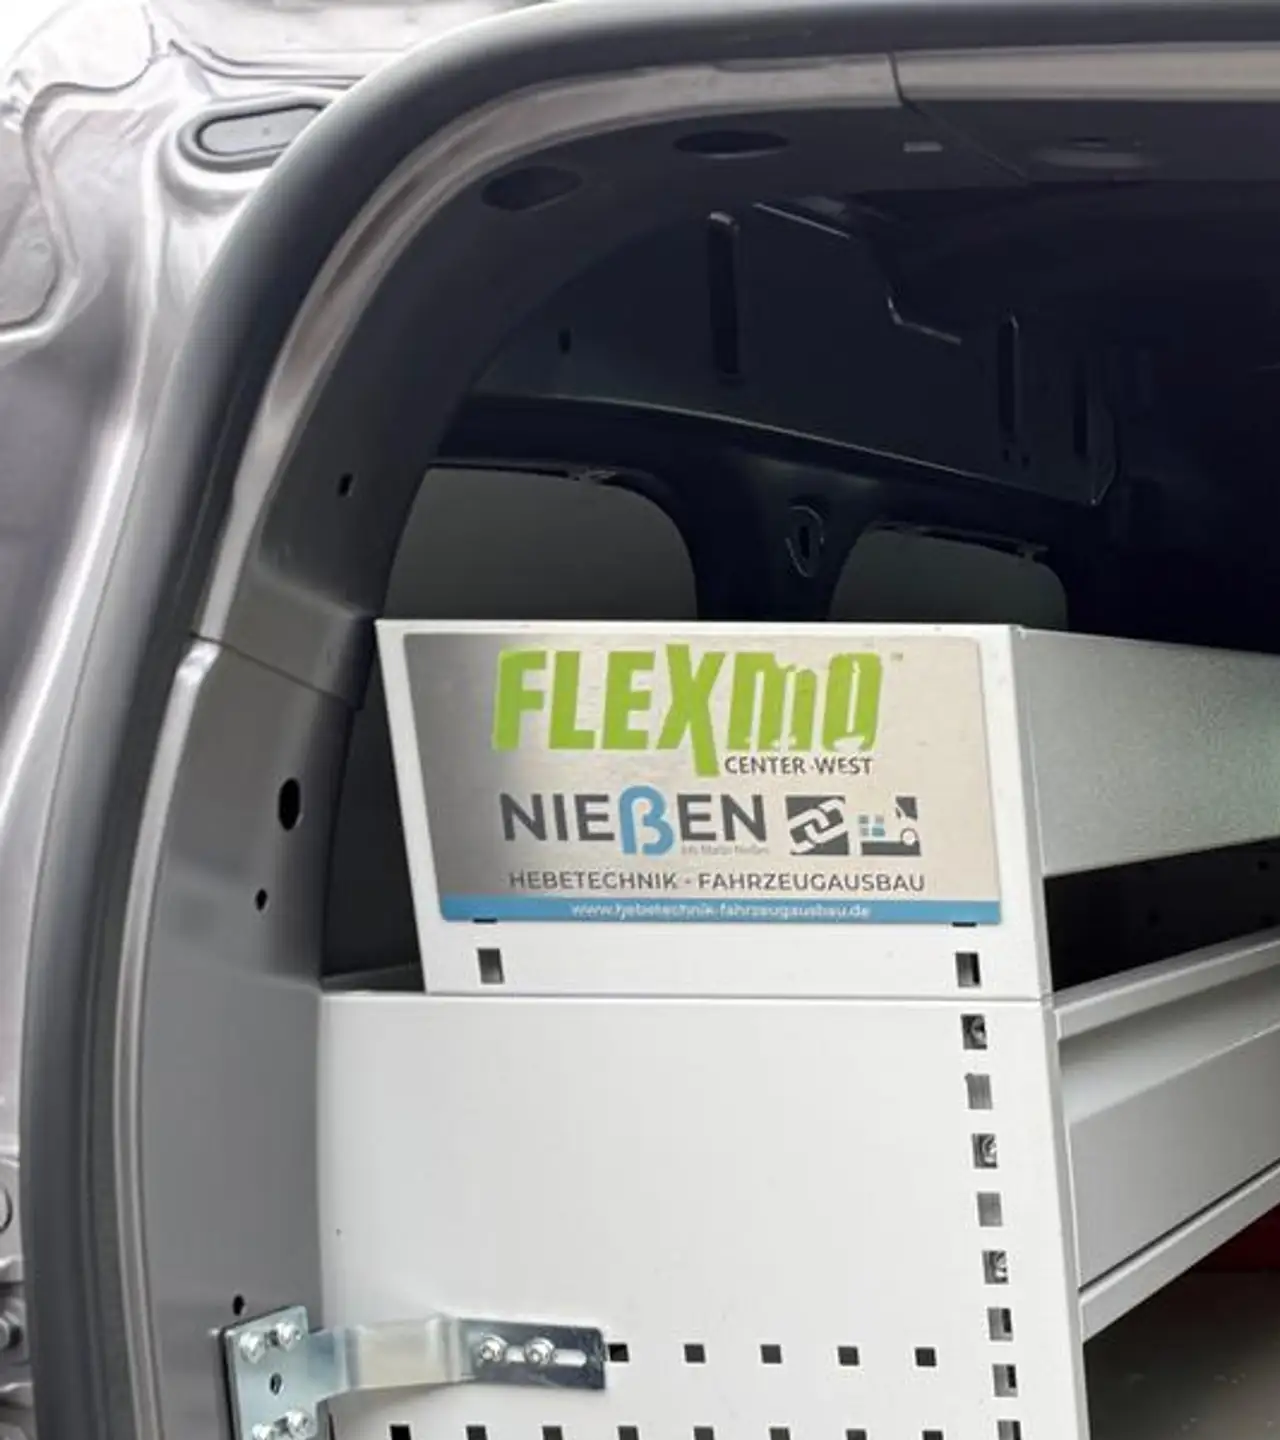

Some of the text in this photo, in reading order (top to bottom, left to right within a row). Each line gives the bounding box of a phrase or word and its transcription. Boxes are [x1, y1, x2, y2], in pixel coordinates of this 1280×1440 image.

[724, 756, 874, 776] CENTER WEST
[500, 783, 768, 856] NIEßEN
[508, 871, 678, 890] HEBETECHNIK
[698, 872, 926, 892] FAHRZEUGAUSBAU
